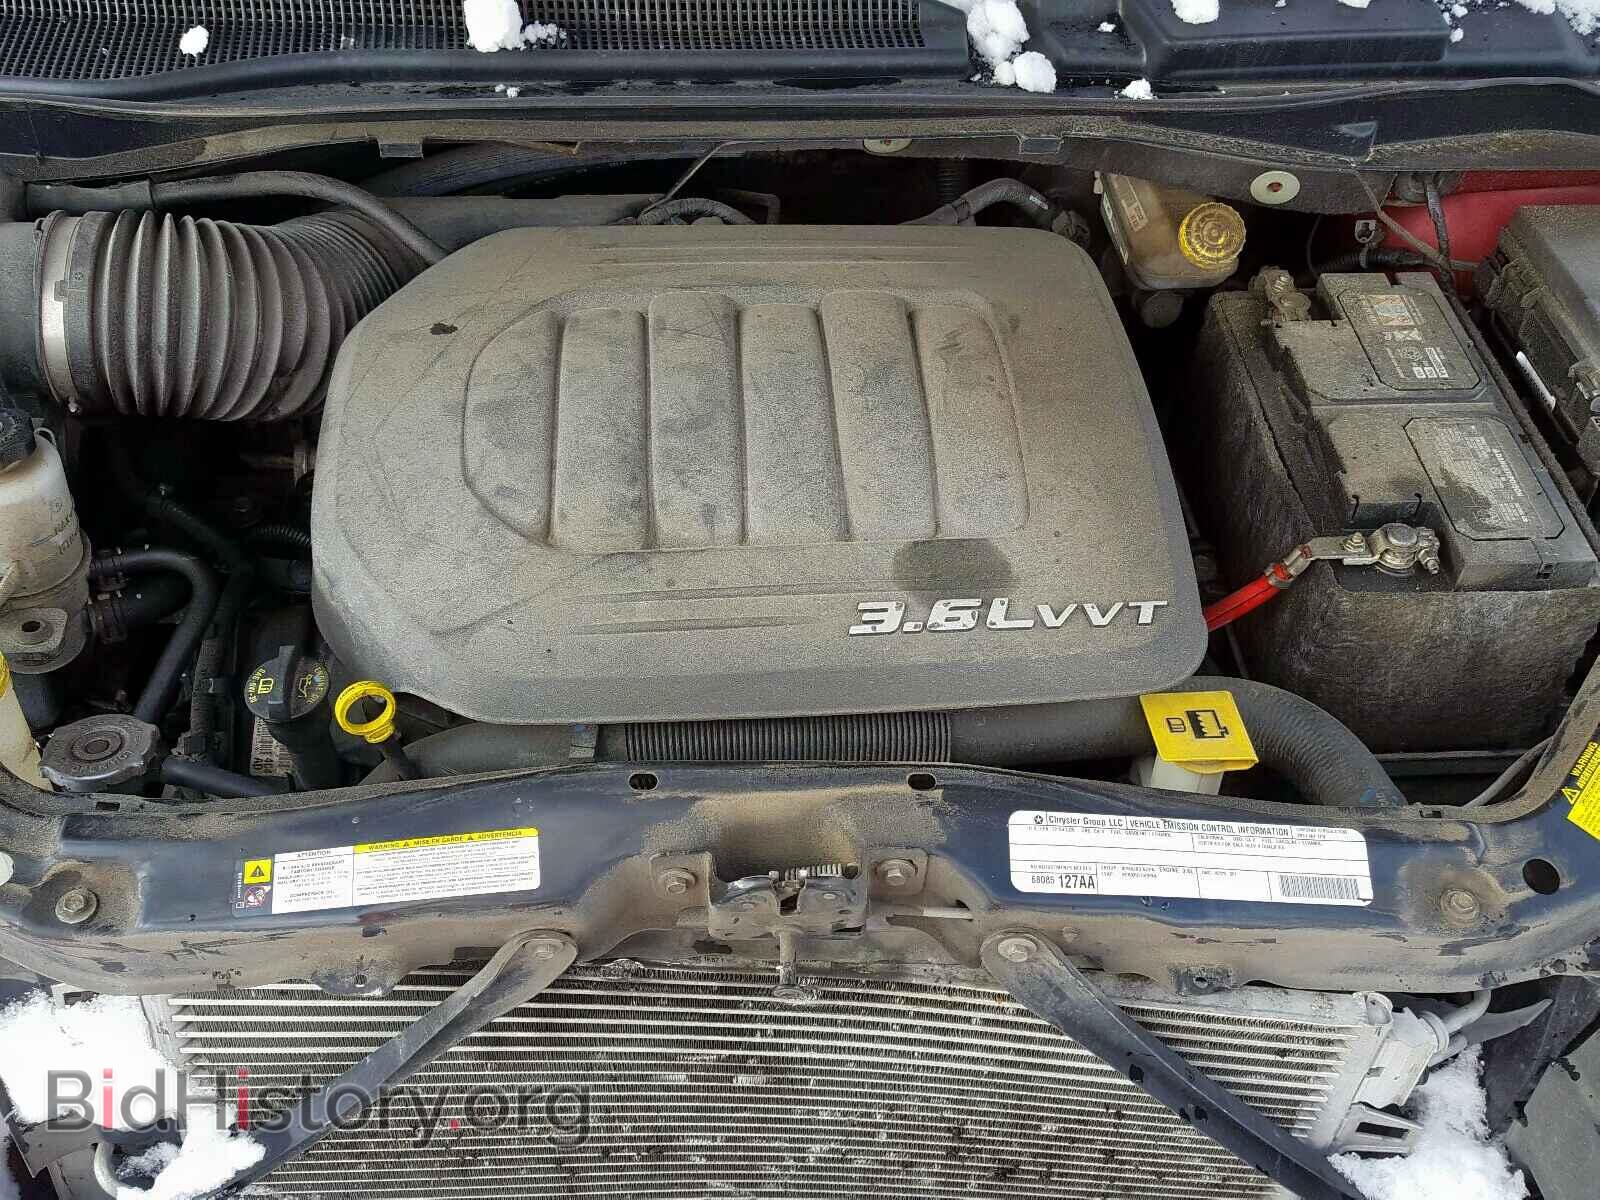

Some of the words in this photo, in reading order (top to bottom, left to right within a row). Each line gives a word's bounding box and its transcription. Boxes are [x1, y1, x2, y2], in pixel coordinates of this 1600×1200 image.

[1570, 740, 1599, 777] WARNING
[1048, 815, 1081, 826] Chrysler
[1083, 816, 1107, 827] Group
[1109, 817, 1123, 827] LLC
[1129, 819, 1161, 829] VEHICLE
[1163, 820, 1199, 831] EMISSION
[1201, 823, 1235, 834] CONTROL
[1238, 825, 1289, 836] INFORMATION
[368, 842, 400, 850] WARNING
[413, 838, 430, 846] MISE
[477, 830, 523, 840] ADVERTENCIA
[297, 850, 331, 858] ATTENTION
[1059, 874, 1095, 889] 127AA
